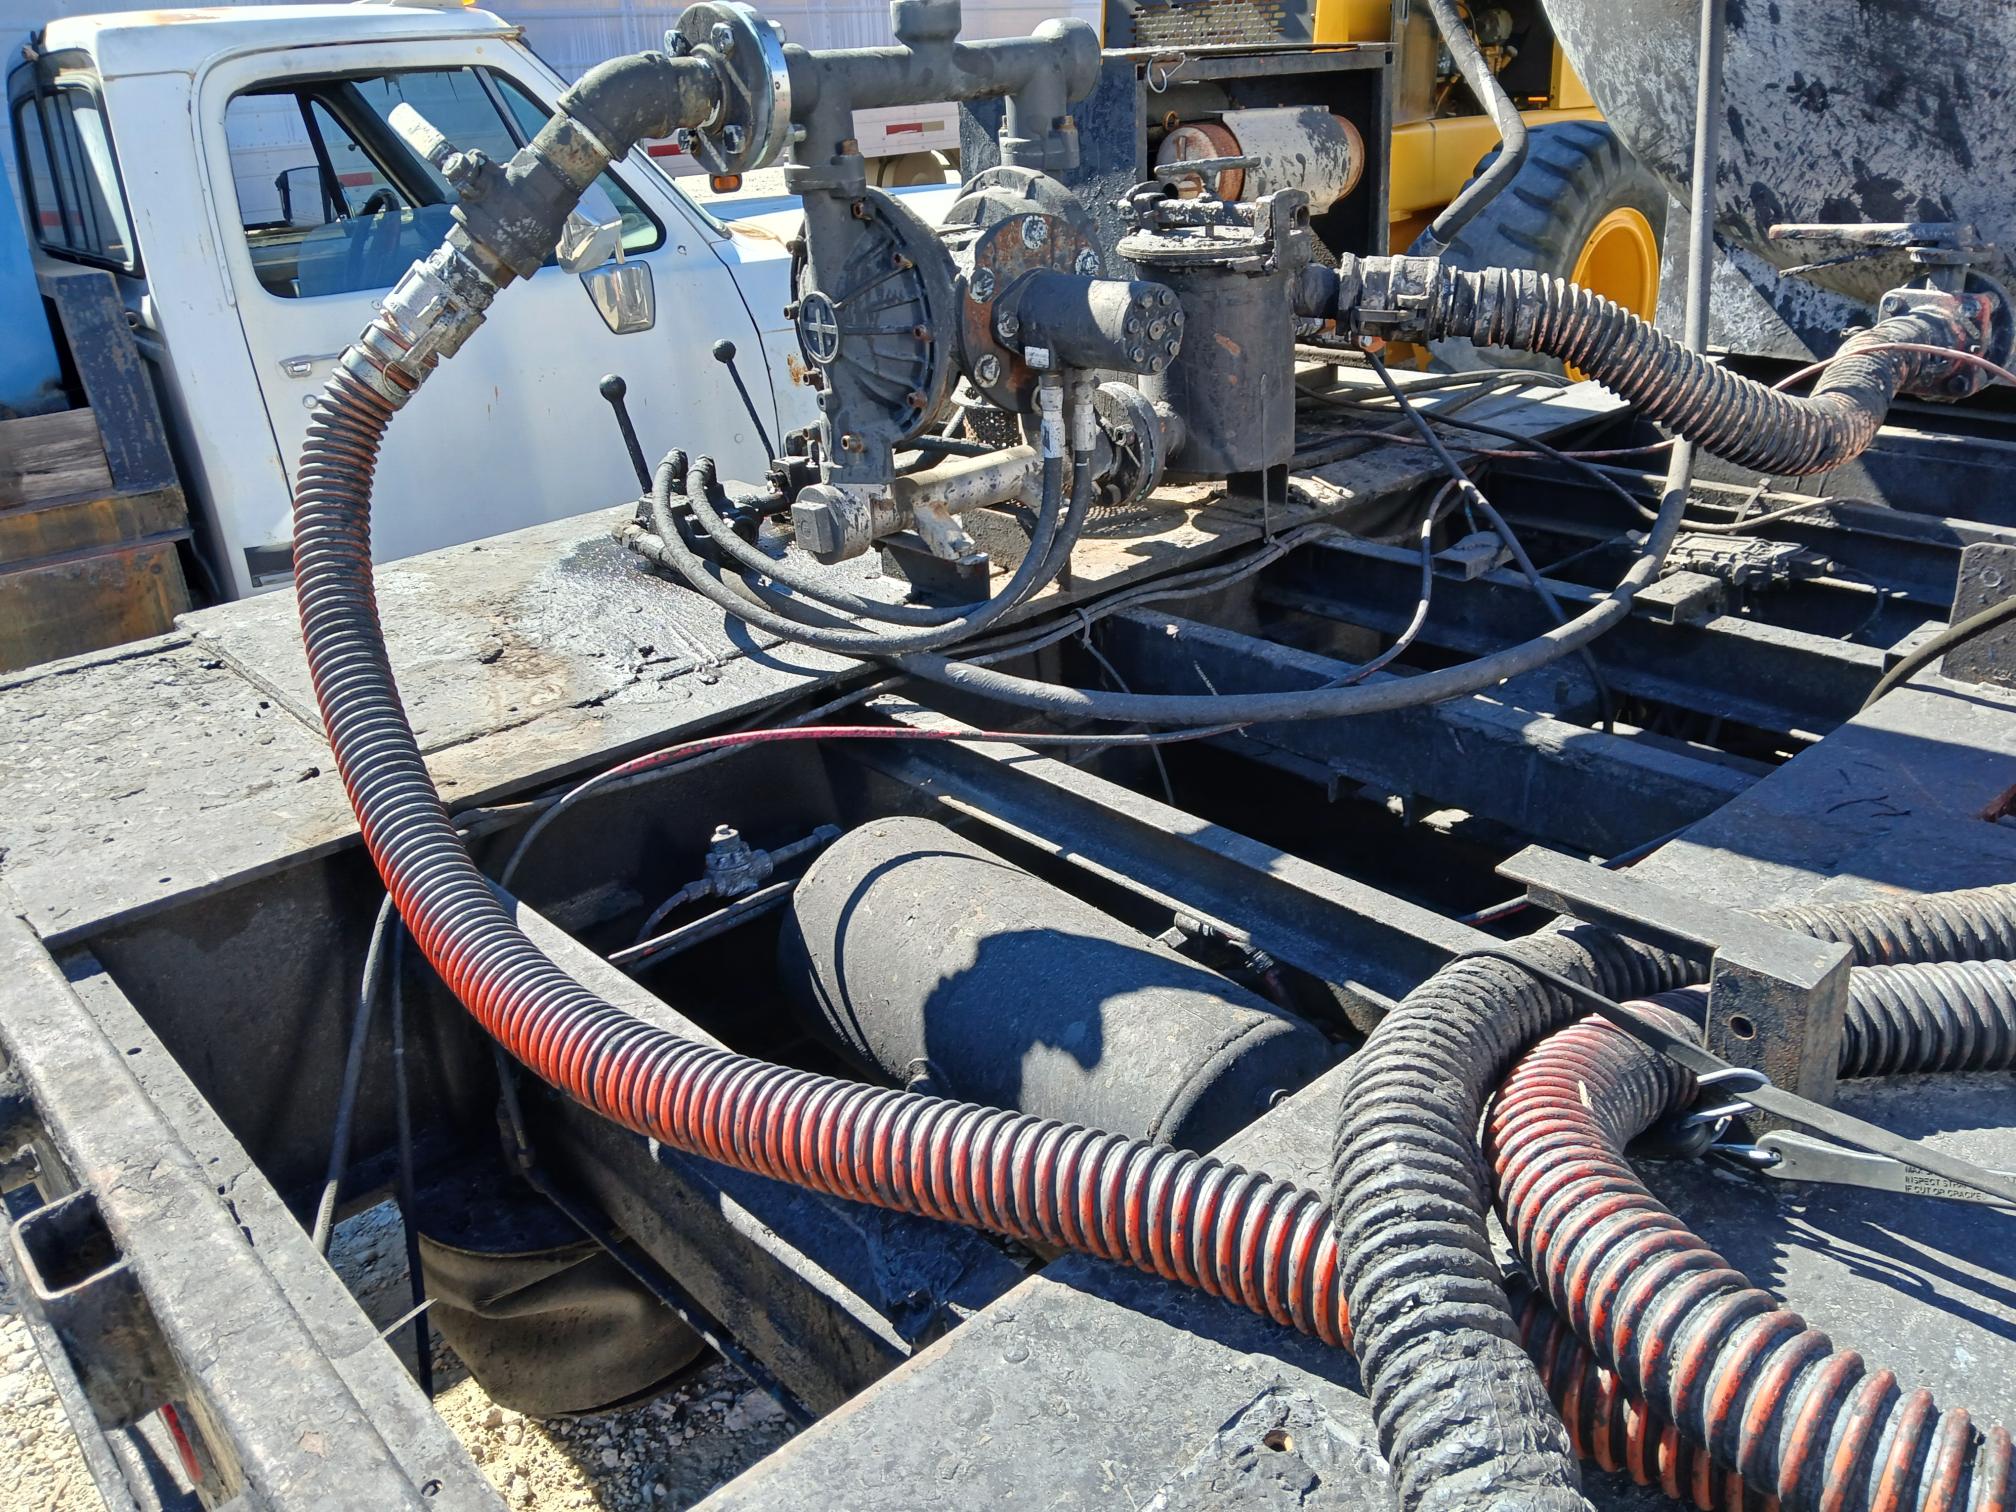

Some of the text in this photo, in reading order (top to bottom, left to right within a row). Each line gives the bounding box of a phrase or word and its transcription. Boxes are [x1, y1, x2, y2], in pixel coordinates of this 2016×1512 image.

[1905, 1176, 1940, 1186] INSPECT
[1905, 1185, 1912, 1193] IF
[1915, 1186, 1931, 1194] CUT
[1933, 1188, 1945, 1196] OR
